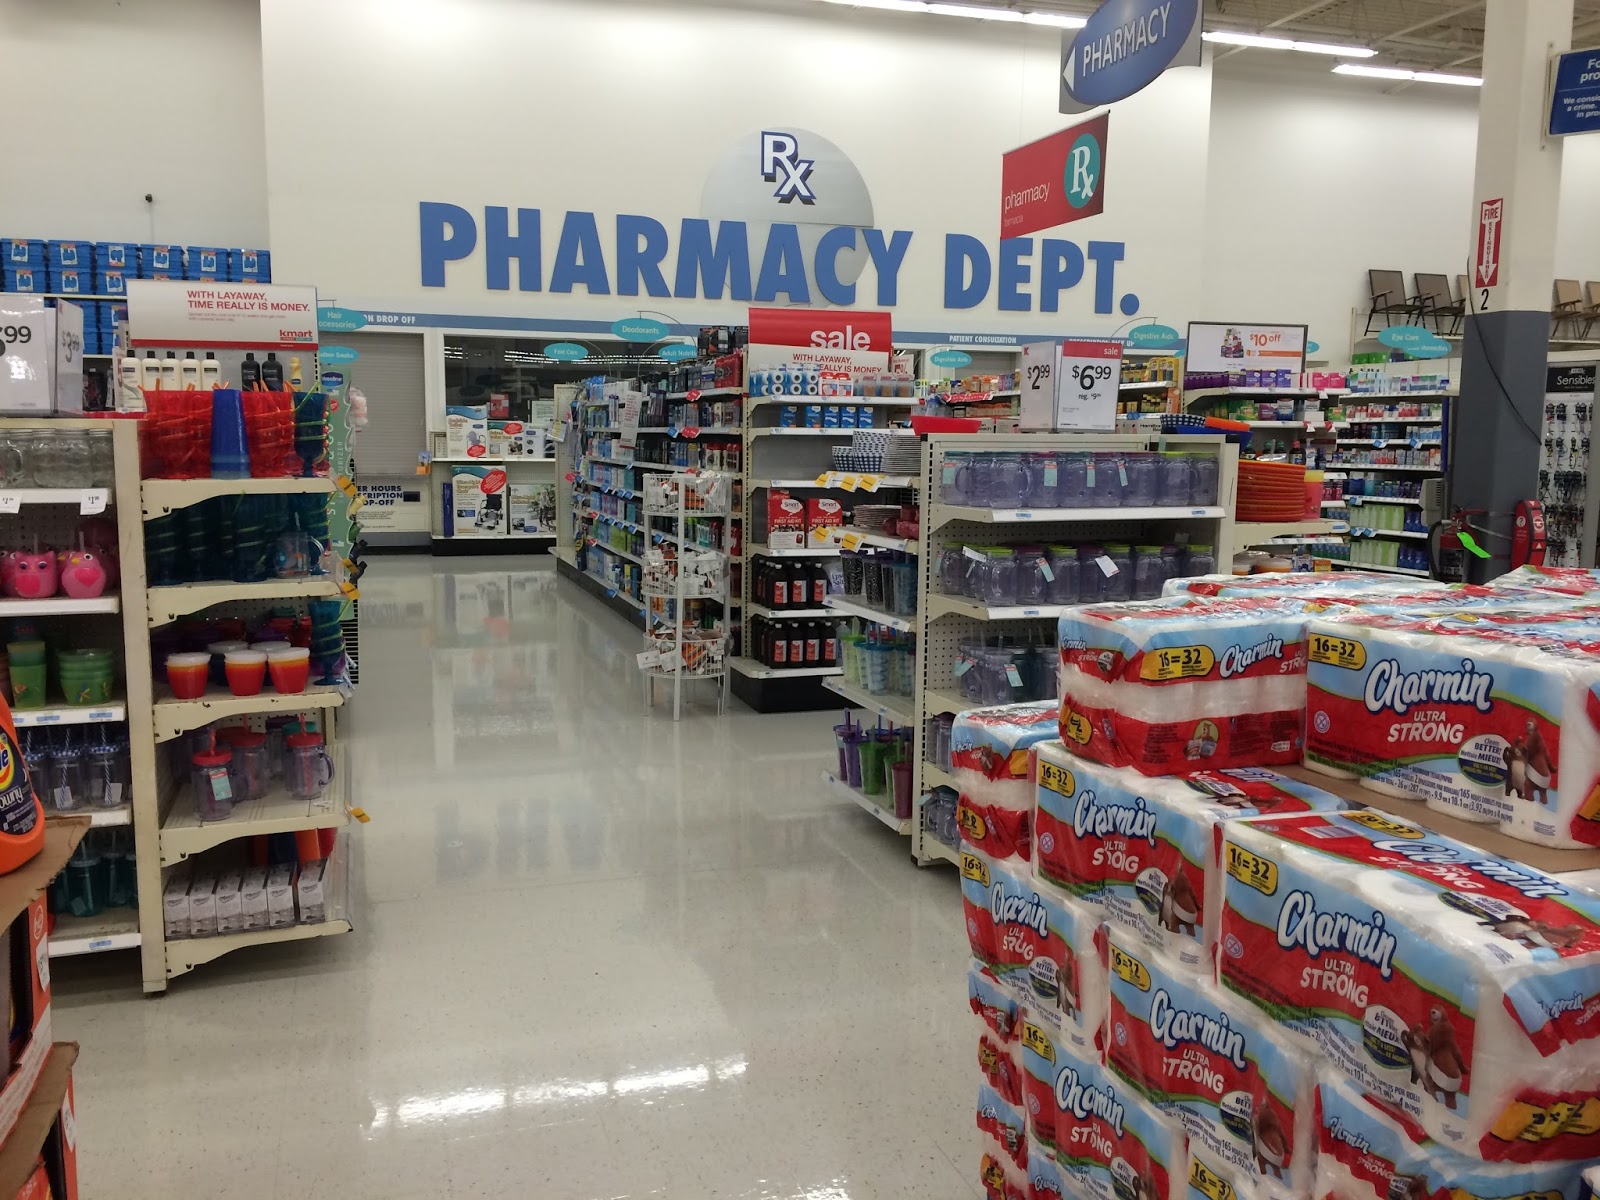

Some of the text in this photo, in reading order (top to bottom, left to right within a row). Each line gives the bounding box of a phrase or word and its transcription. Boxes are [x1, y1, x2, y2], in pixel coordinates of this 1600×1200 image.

[1083, 6, 1171, 77] PHARMACY
[1588, 58, 1600, 69] Fo
[1580, 72, 1600, 84] pro
[761, 131, 816, 199] Rx
[1070, 145, 1094, 199] Rx
[1004, 182, 1050, 214] pharmacy
[1483, 207, 1500, 221] FIRE
[1484, 221, 1493, 279] EXTINGUISHER
[419, 201, 1140, 316] PHARMACY DEPT.
[187, 291, 267, 302] WITH LAYAWAY,
[1480, 289, 1489, 311] 2
[188, 301, 311, 312] TIME REALLY IS MONEY.
[327, 311, 343, 319] Hair
[376, 314, 399, 323] DROP
[401, 316, 416, 324] OFF
[318, 320, 357, 328] ccessories
[621, 325, 660, 335] Deodorants
[279, 329, 313, 338] kmart
[810, 325, 871, 351] sale
[949, 335, 1017, 344] PATIENT CONSULTATION
[1133, 332, 1174, 340] Digestive Aids
[1249, 334, 1281, 347] $10 off
[1103, 346, 1118, 355] sale
[792, 353, 852, 365] WITH LAYAWAY,
[819, 364, 842, 372] EALLY
[1556, 375, 1595, 386] Sensibles
[1314, 637, 1356, 658] 16=32
[1219, 633, 1284, 679] Charmin
[1365, 658, 1494, 713] Charmin
[1413, 710, 1447, 722] ULTRA
[1387, 723, 1465, 745] STRONG
[1277, 889, 1397, 982] Charmin
[1324, 958, 1355, 976] ULTRA
[1300, 967, 1369, 1008] STRONG
[1183, 1049, 1210, 1067] ULTRA
